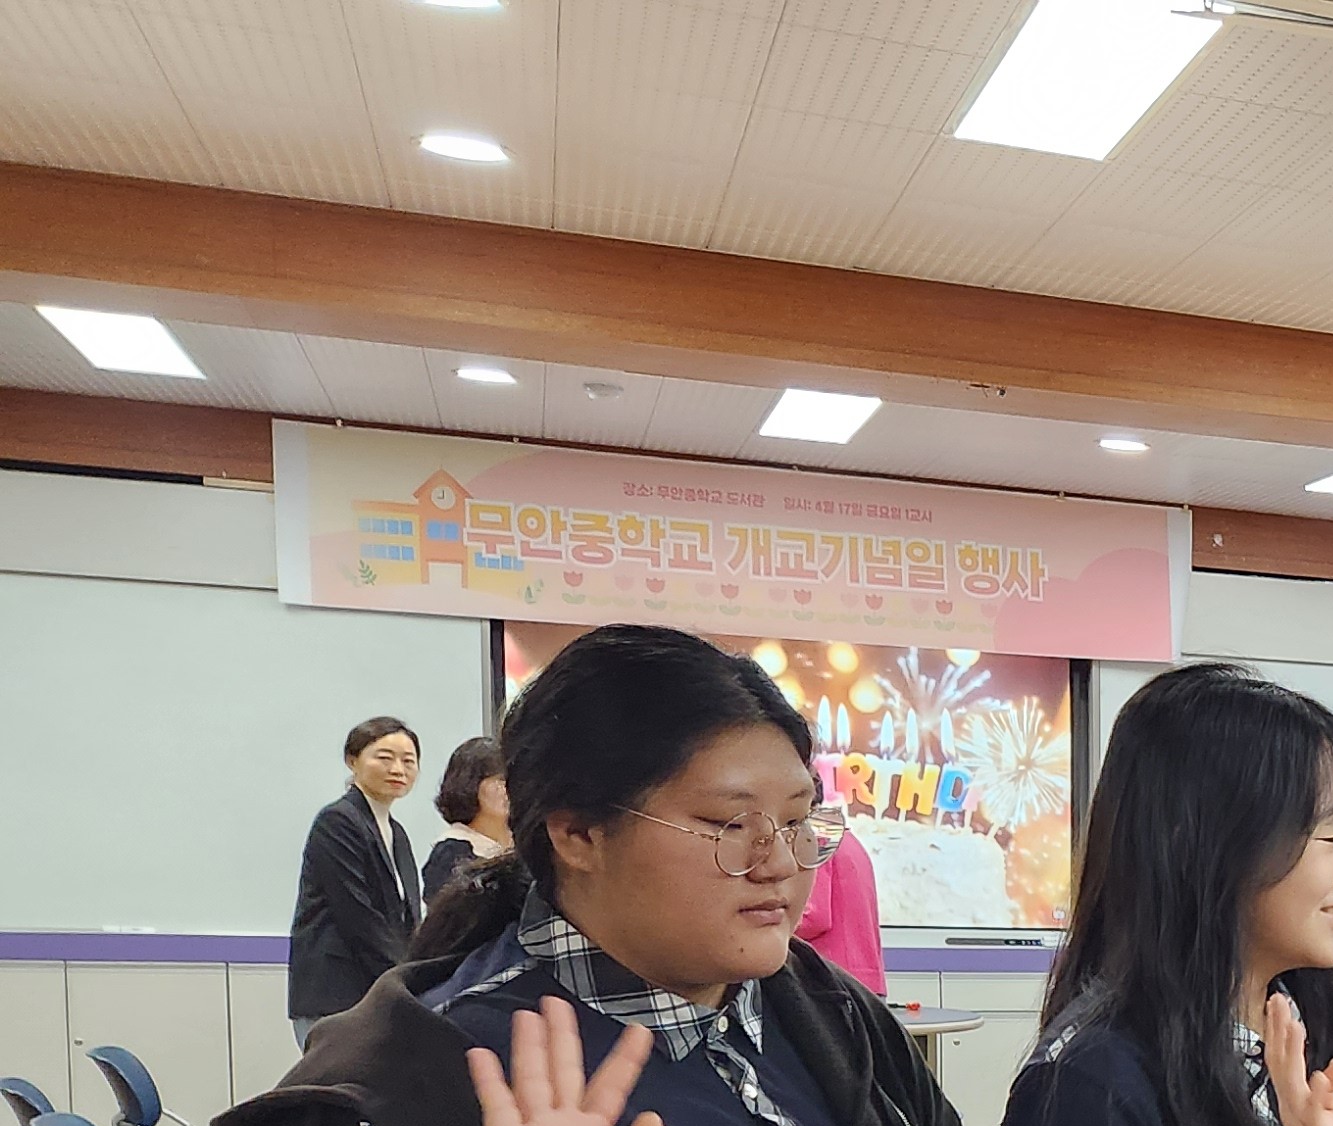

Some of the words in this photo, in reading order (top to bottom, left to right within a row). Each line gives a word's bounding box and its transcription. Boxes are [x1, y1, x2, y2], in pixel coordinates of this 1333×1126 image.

[623, 482, 653, 497] 장소:
[657, 484, 723, 503] 무안중학교
[727, 491, 766, 509] 도서관
[783, 496, 812, 511] 일시:
[815, 500, 835, 515] 4월
[838, 502, 863, 517] 17일
[866, 504, 902, 521] 금요일
[905, 508, 933, 524] 1교시
[465, 500, 715, 573] 무안중학교
[725, 522, 947, 592] 개교기념일
[955, 540, 1048, 600] 행사
